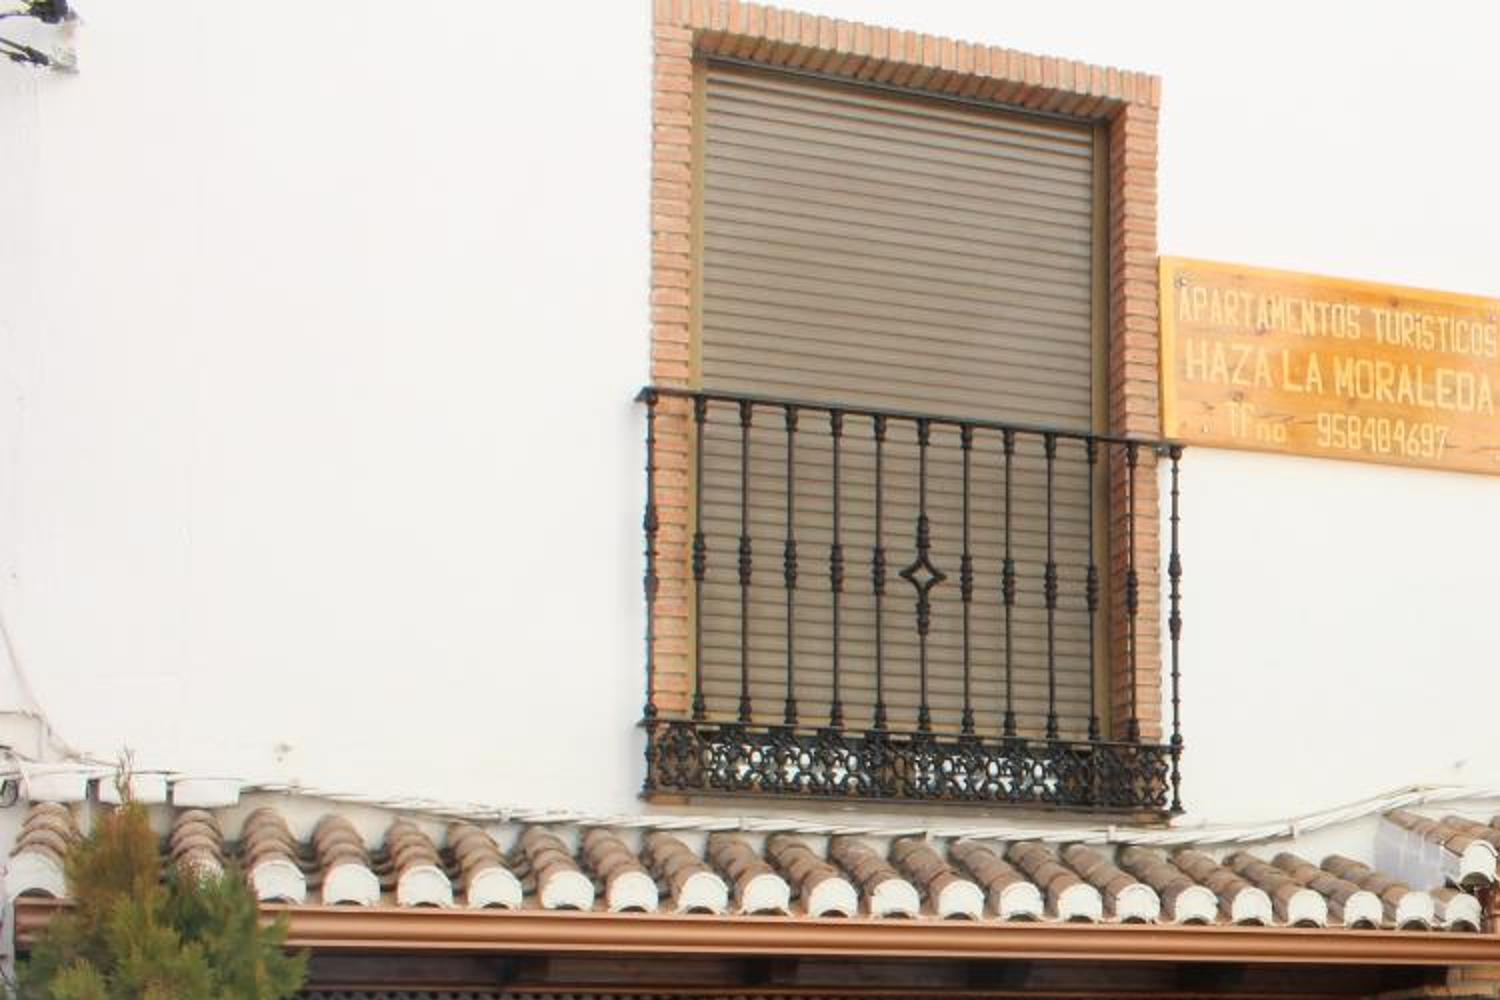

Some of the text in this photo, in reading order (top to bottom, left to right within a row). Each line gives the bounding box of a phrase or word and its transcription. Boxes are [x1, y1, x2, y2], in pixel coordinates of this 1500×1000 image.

[1179, 286, 1361, 339] APARTAMENTOS
[1184, 339, 1495, 415] HAZA LA MORALEDA
